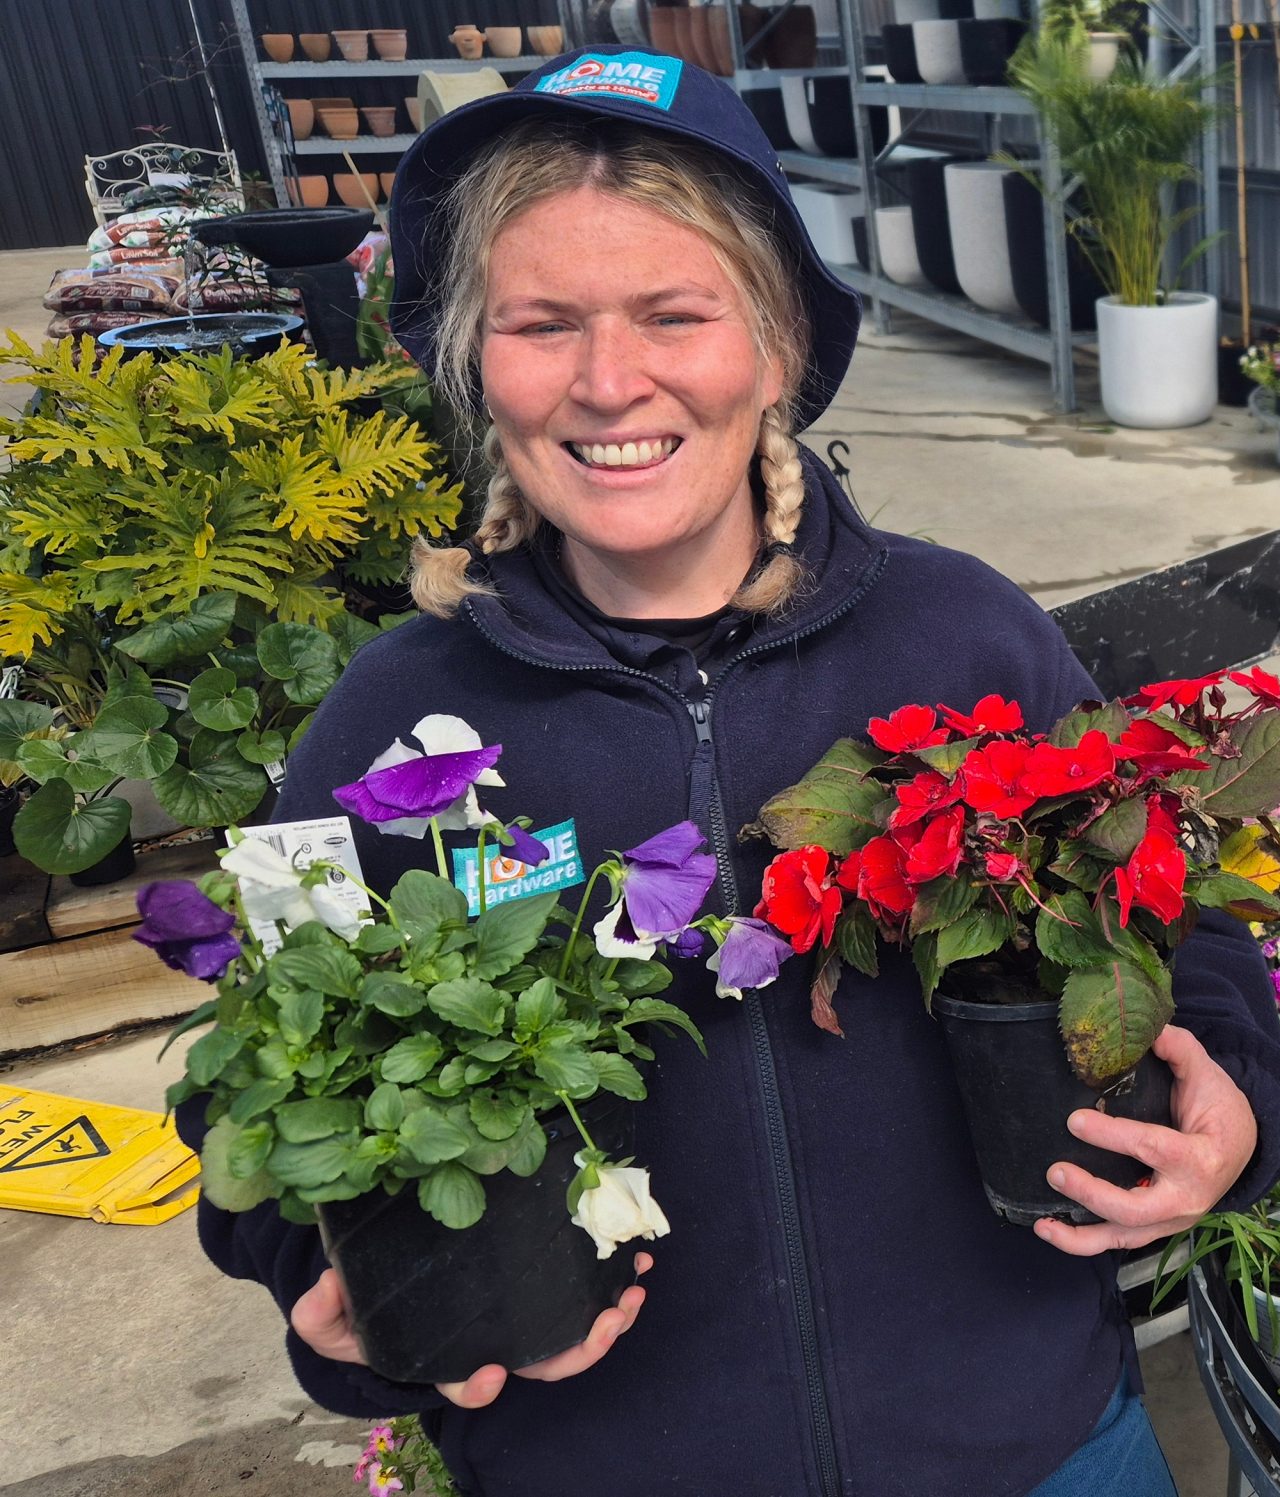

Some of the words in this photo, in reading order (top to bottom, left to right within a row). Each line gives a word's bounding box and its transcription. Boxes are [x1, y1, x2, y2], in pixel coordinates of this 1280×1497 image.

[547, 61, 666, 88] HOME
[121, 251, 143, 260] Lawn
[468, 861, 577, 908] Hardware
